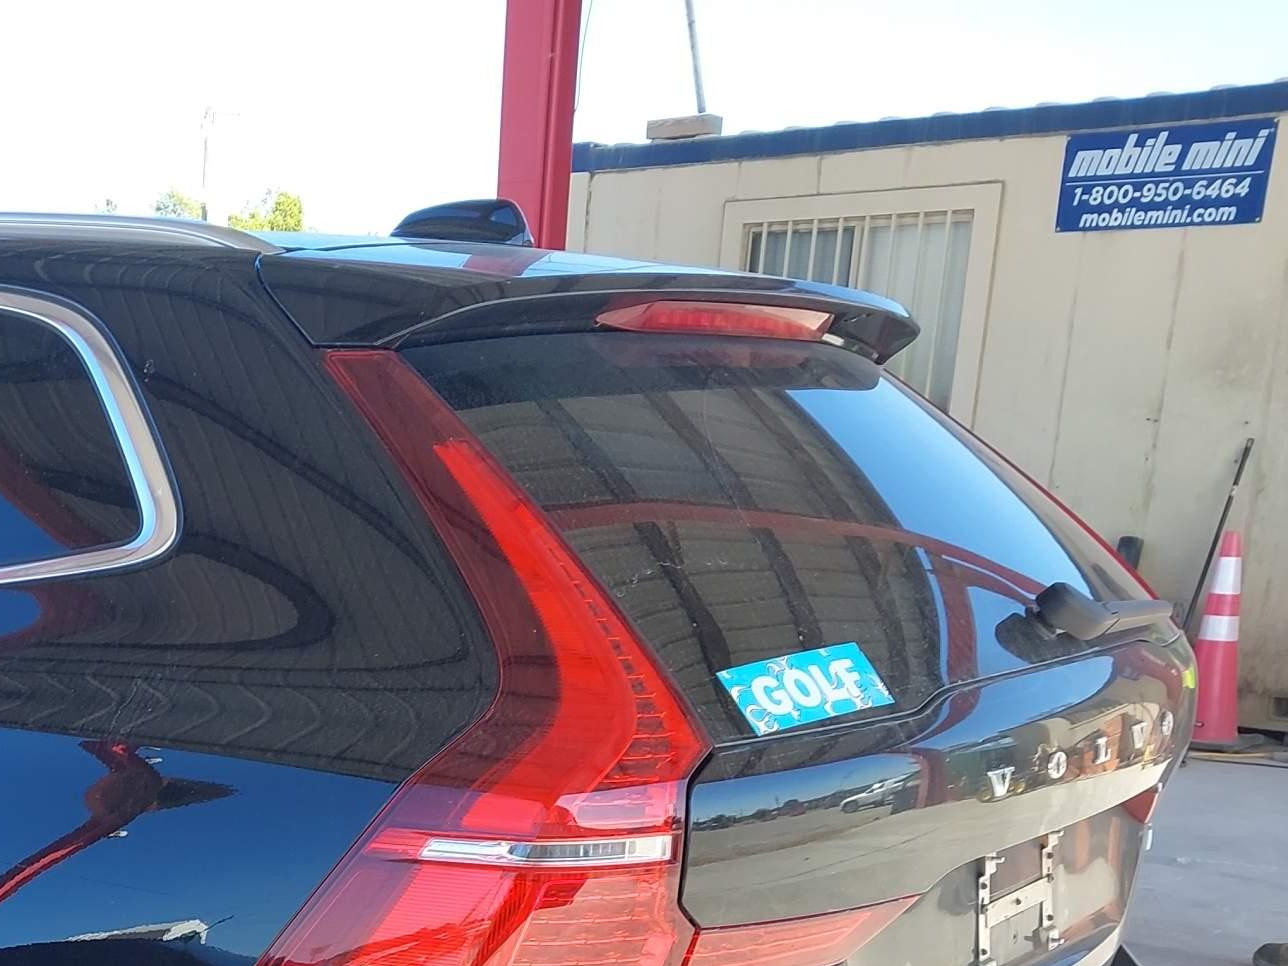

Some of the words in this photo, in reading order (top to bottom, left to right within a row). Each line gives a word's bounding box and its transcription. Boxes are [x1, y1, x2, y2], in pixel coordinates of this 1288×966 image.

[1068, 131, 1182, 178] mobile
[1181, 129, 1268, 171] mini
[1072, 177, 1252, 206] 1-800-950-6464
[1079, 205, 1237, 228] mobilemini.com
[751, 658, 861, 715] GOLF
[986, 710, 1174, 797] VOLVO
